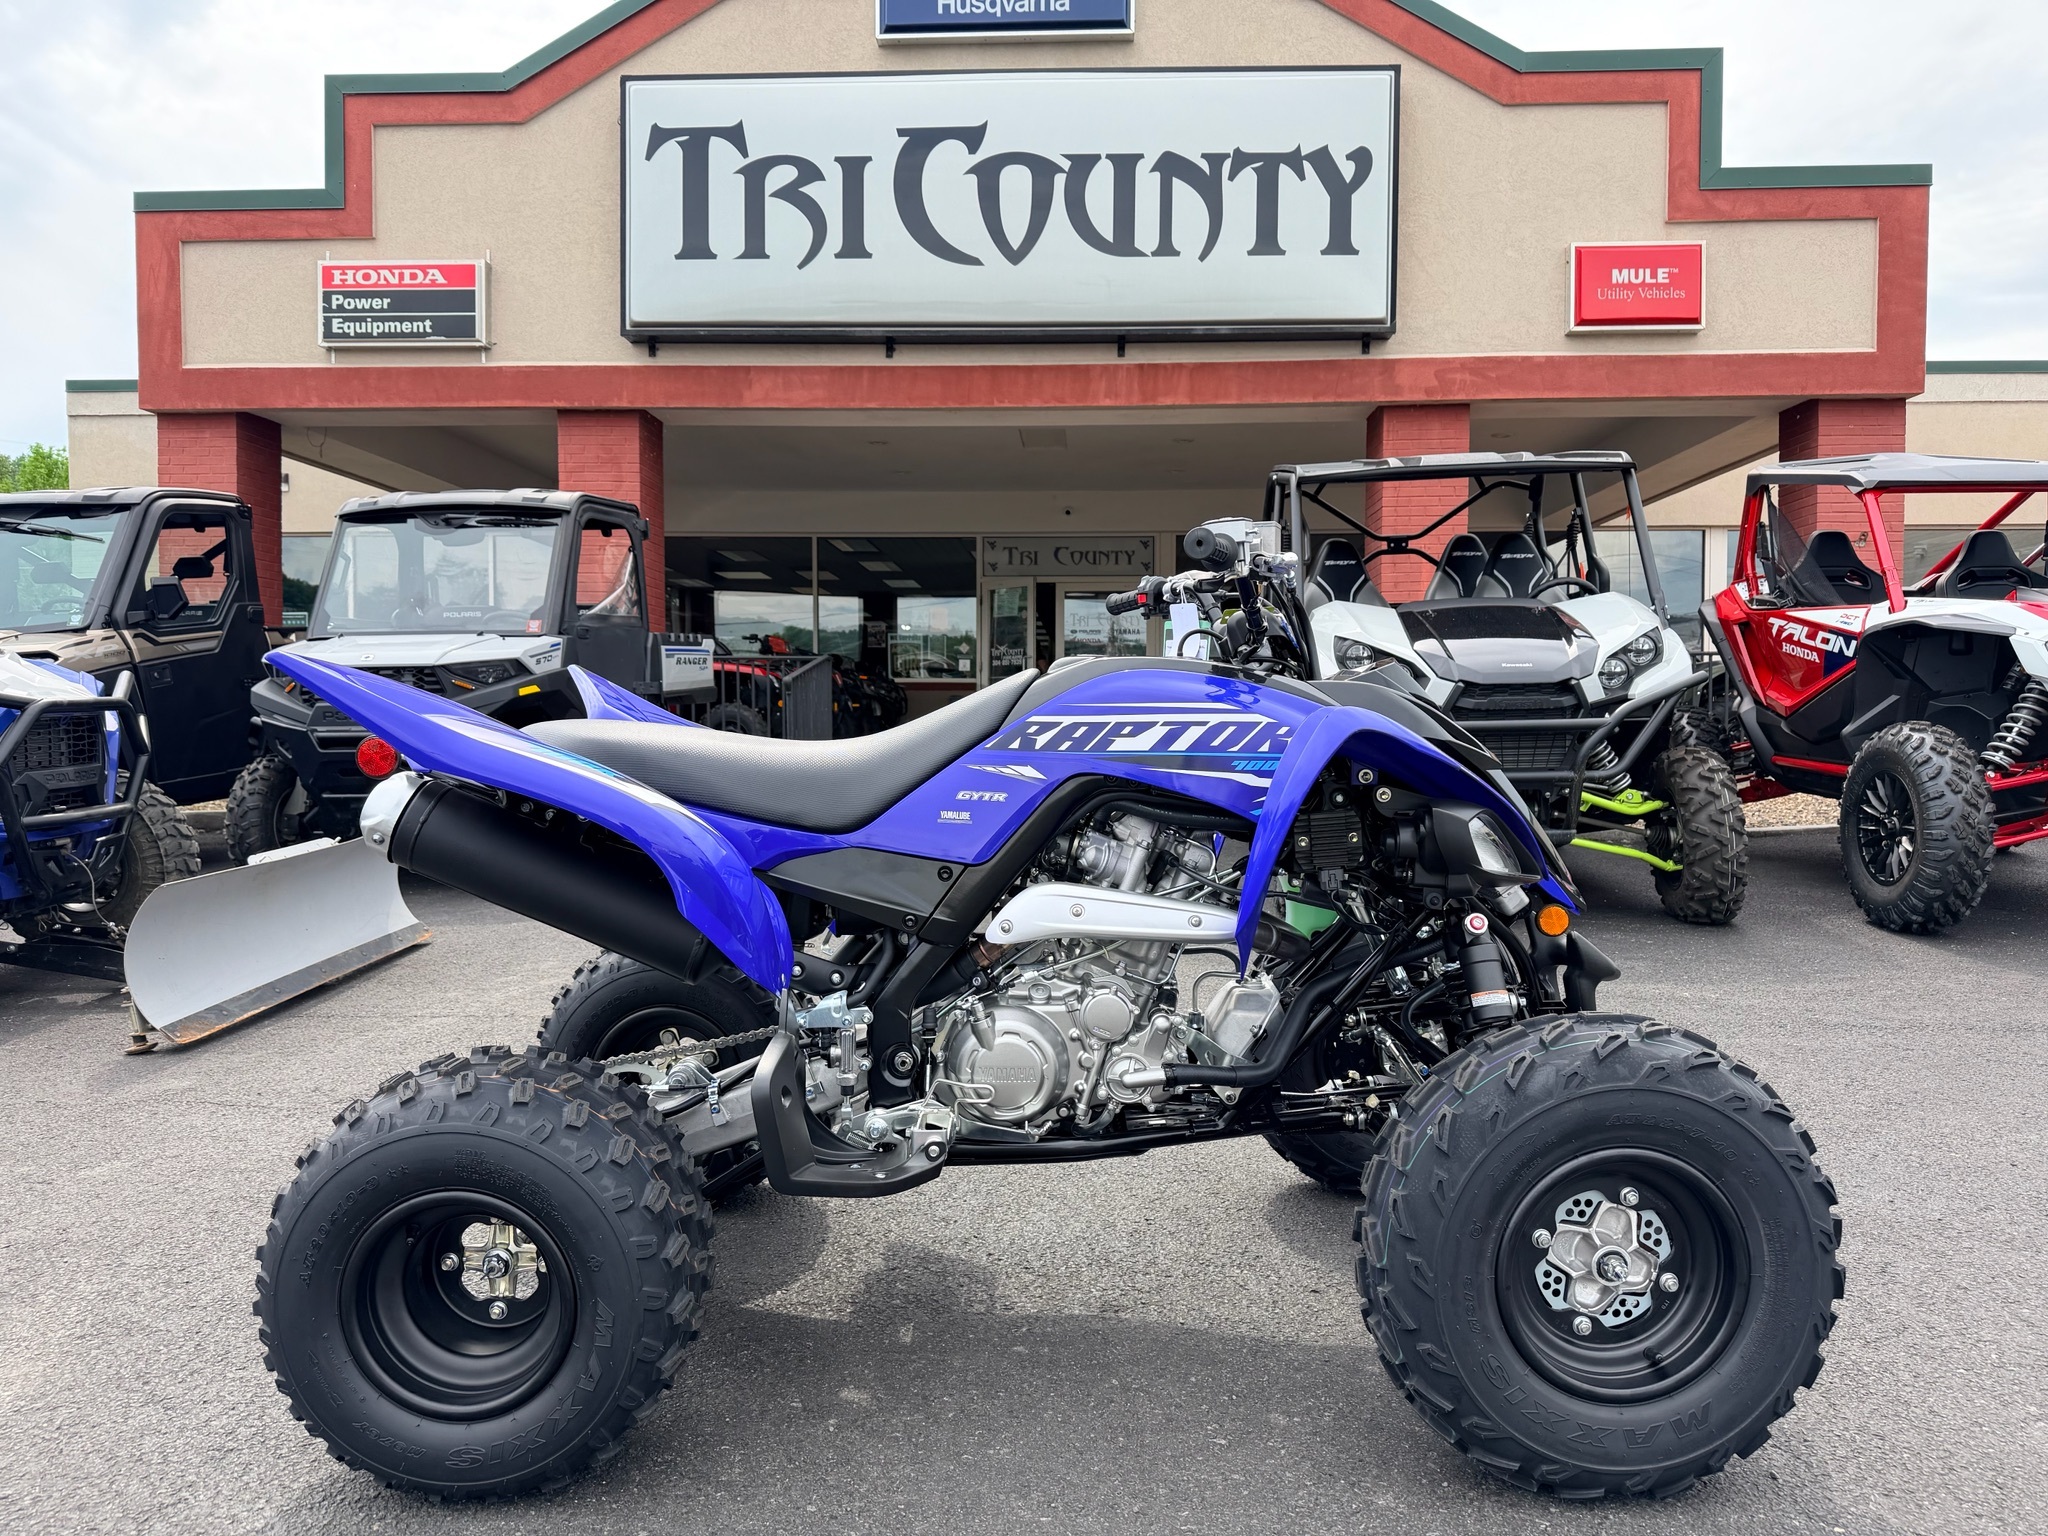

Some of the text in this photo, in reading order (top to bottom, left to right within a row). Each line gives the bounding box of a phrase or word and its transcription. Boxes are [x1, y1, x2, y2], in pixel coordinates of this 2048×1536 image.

[645, 119, 1374, 270] TRI COUNTY
[331, 269, 448, 285] HONDA
[331, 295, 391, 309] Power
[1597, 286, 1686, 302] Utility Vehicles
[331, 318, 433, 336] Equipment
[1768, 617, 1858, 658] TALON
[676, 656, 708, 665] RANGER
[1782, 642, 1820, 663] HONDA
[988, 721, 1296, 751] RAPTOR
[956, 790, 1008, 802] GYTR
[940, 810, 971, 820] YAMALUBE
[979, 1066, 1036, 1082] YAMAHA
[444, 1297, 615, 1469] MAXXIS
[1480, 1352, 1713, 1449] MAXXIS
